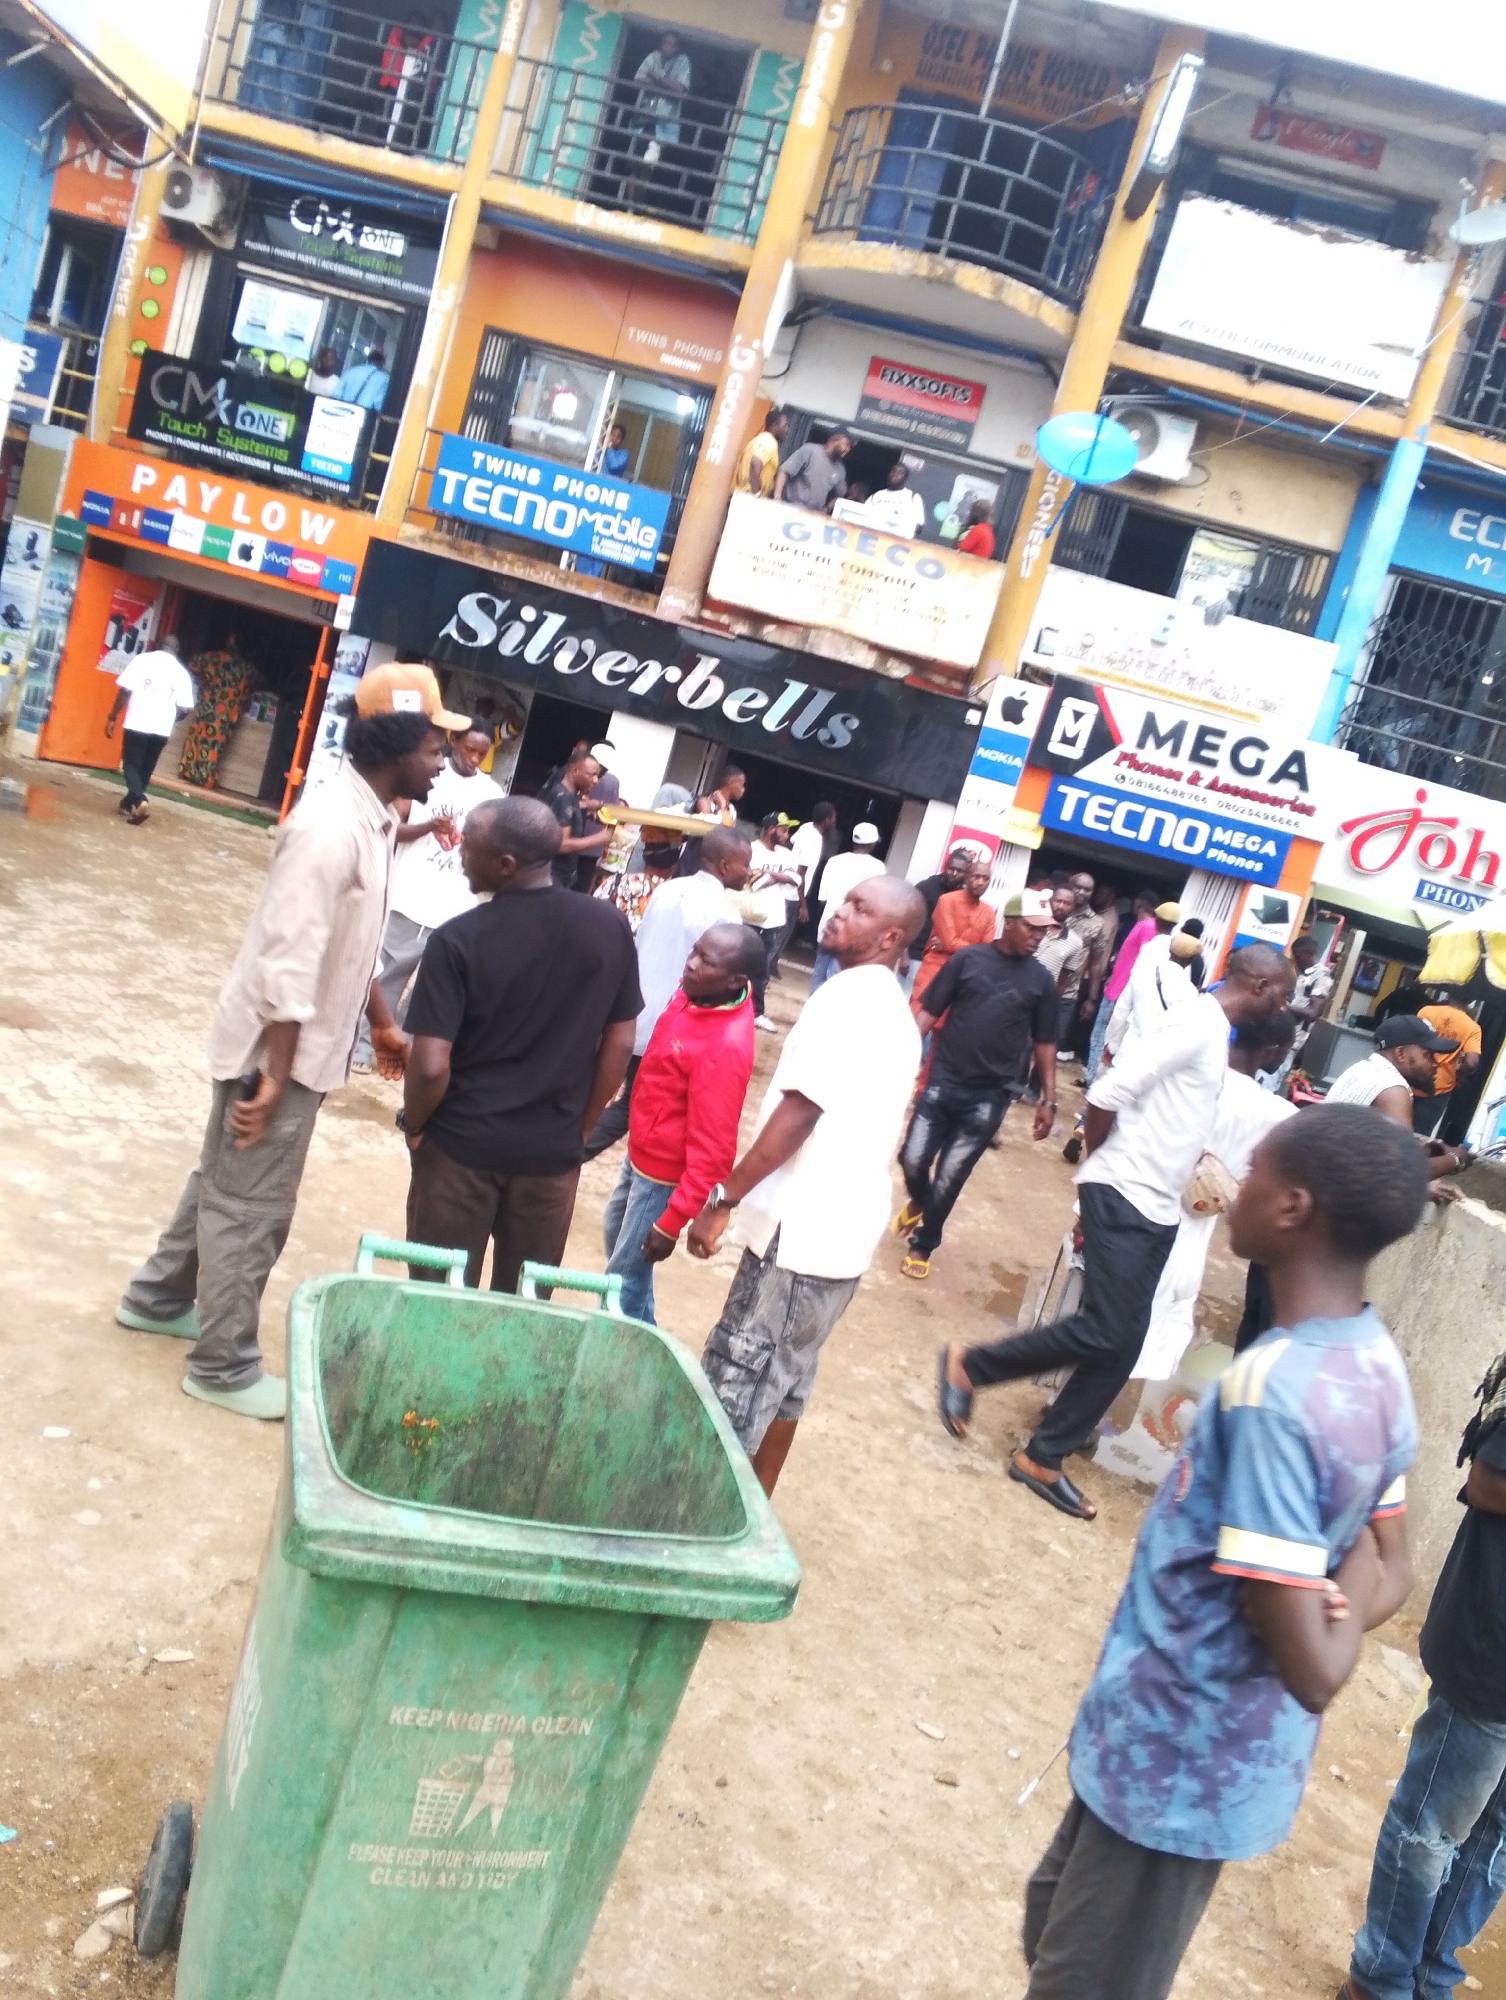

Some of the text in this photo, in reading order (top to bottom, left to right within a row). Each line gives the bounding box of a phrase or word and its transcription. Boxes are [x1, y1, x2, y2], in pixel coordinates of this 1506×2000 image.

[628, 326, 668, 350] TWINS
[673, 339, 723, 364] PHONES
[1243, 336, 1382, 380] COMMUNICATION
[879, 364, 972, 404] FIXXSOFTS
[158, 410, 207, 439] Touch
[216, 427, 290, 463] Systems
[705, 372, 744, 465] GIONEE
[131, 463, 335, 546] PAYLOW
[438, 467, 578, 539] TECNO
[472, 450, 630, 512] TWINS PHONE
[781, 520, 947, 581] GRECO
[1449, 508, 1506, 552] EC
[769, 541, 917, 590] OPTICAL COMPANY
[440, 591, 861, 750] Silverbells
[976, 747, 1023, 768] NOKIA
[1135, 710, 1310, 793] MEGA
[1113, 750, 1317, 817] Phones & Accessories
[1057, 784, 1211, 855] TECNO
[1211, 826, 1277, 858] MEGA
[1206, 847, 1264, 873] Phones
[390, 1706, 594, 1736] KEEP NIGERIA CLEAN
[369, 1868, 430, 1889] CLEAN
[396, 1847, 429, 1867] KEEP
[431, 1850, 464, 1869] YOUR
